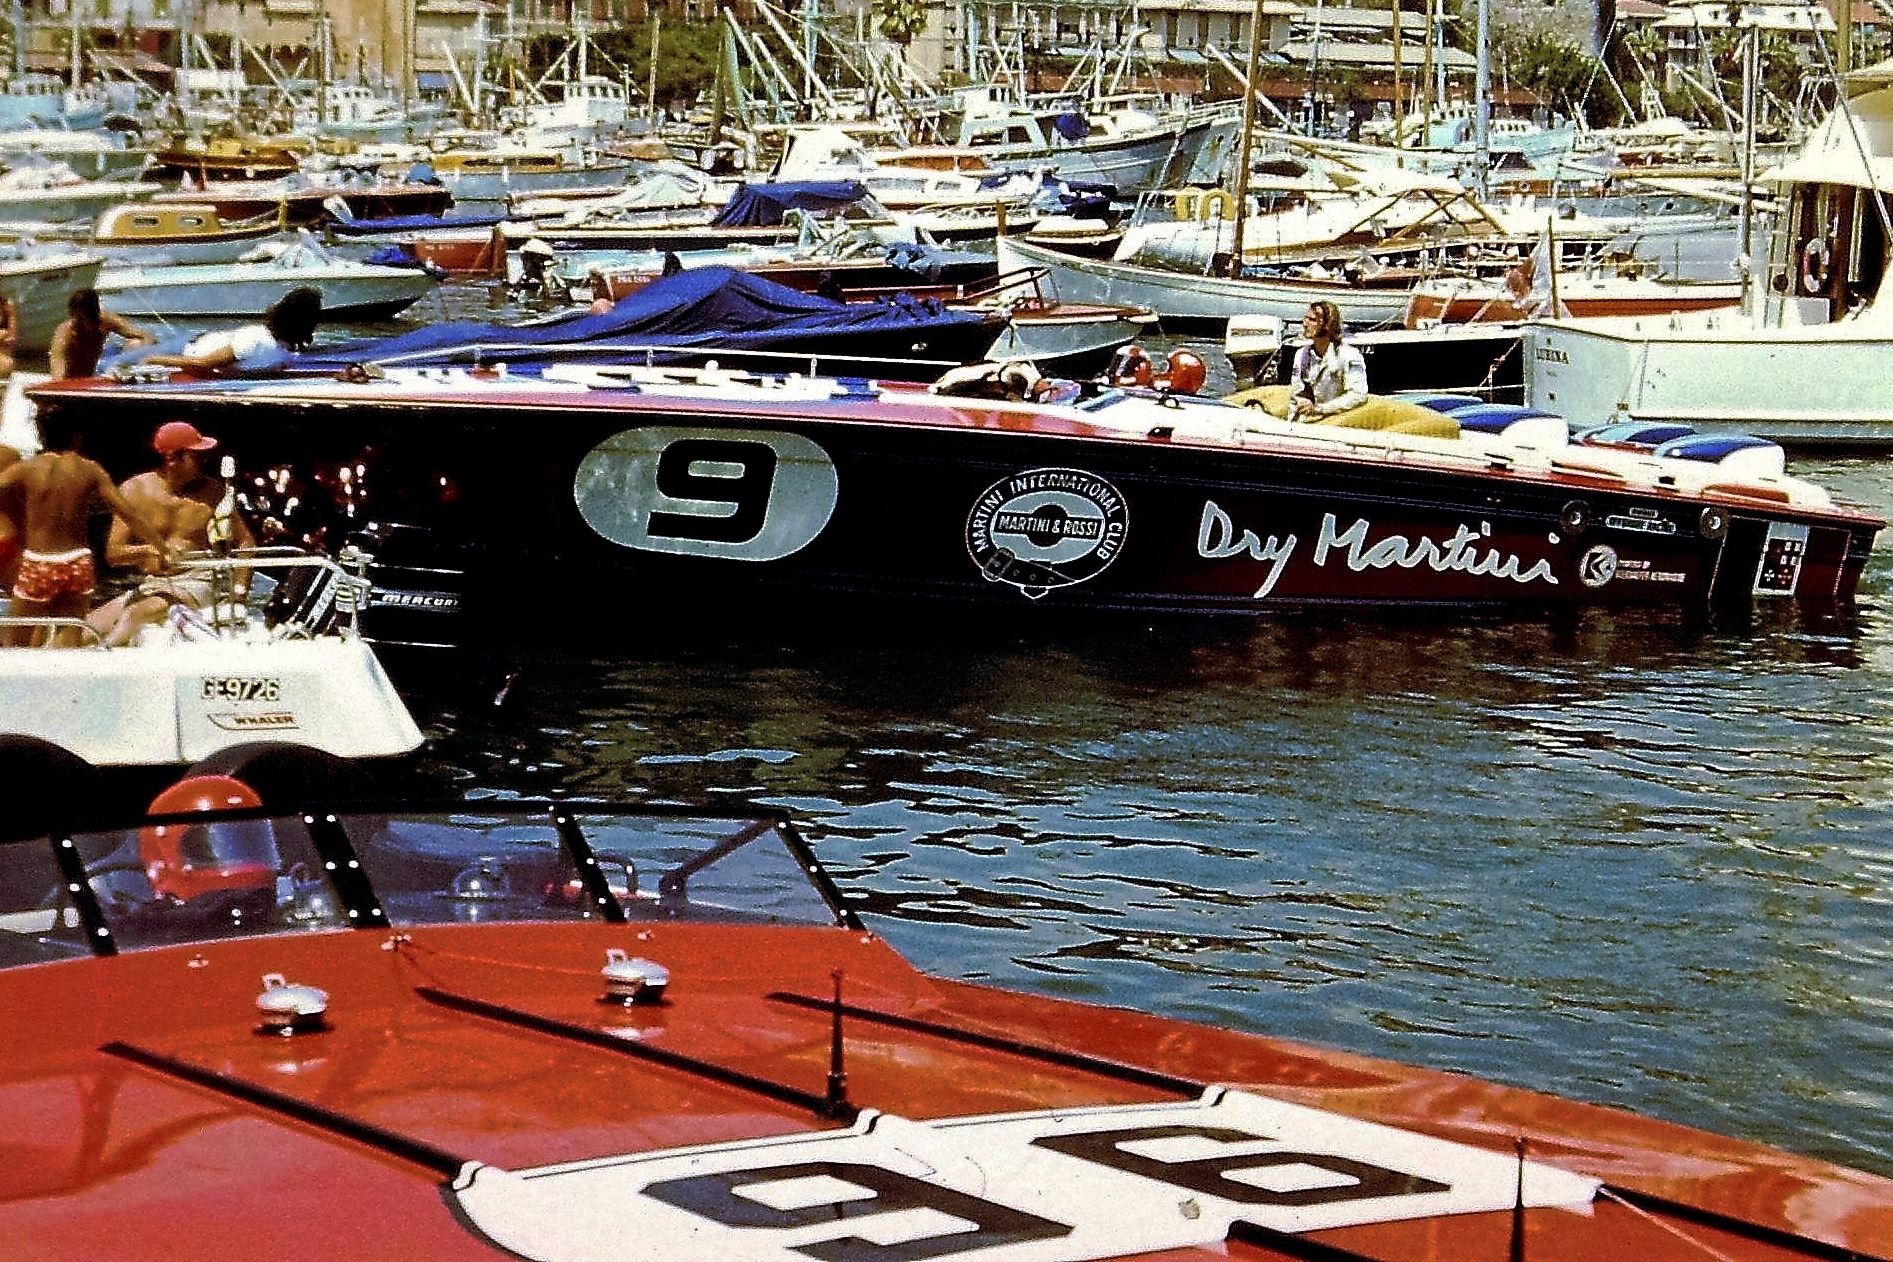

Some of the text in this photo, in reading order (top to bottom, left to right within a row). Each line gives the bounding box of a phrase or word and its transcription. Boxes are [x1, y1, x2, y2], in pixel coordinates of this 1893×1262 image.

[647, 438, 777, 546] 9
[972, 473, 1123, 560] MARTINI INTERNATIONAL CLUB
[998, 515, 1099, 537] MARTINI & ROSSI
[1197, 499, 1561, 599] Dry Martini
